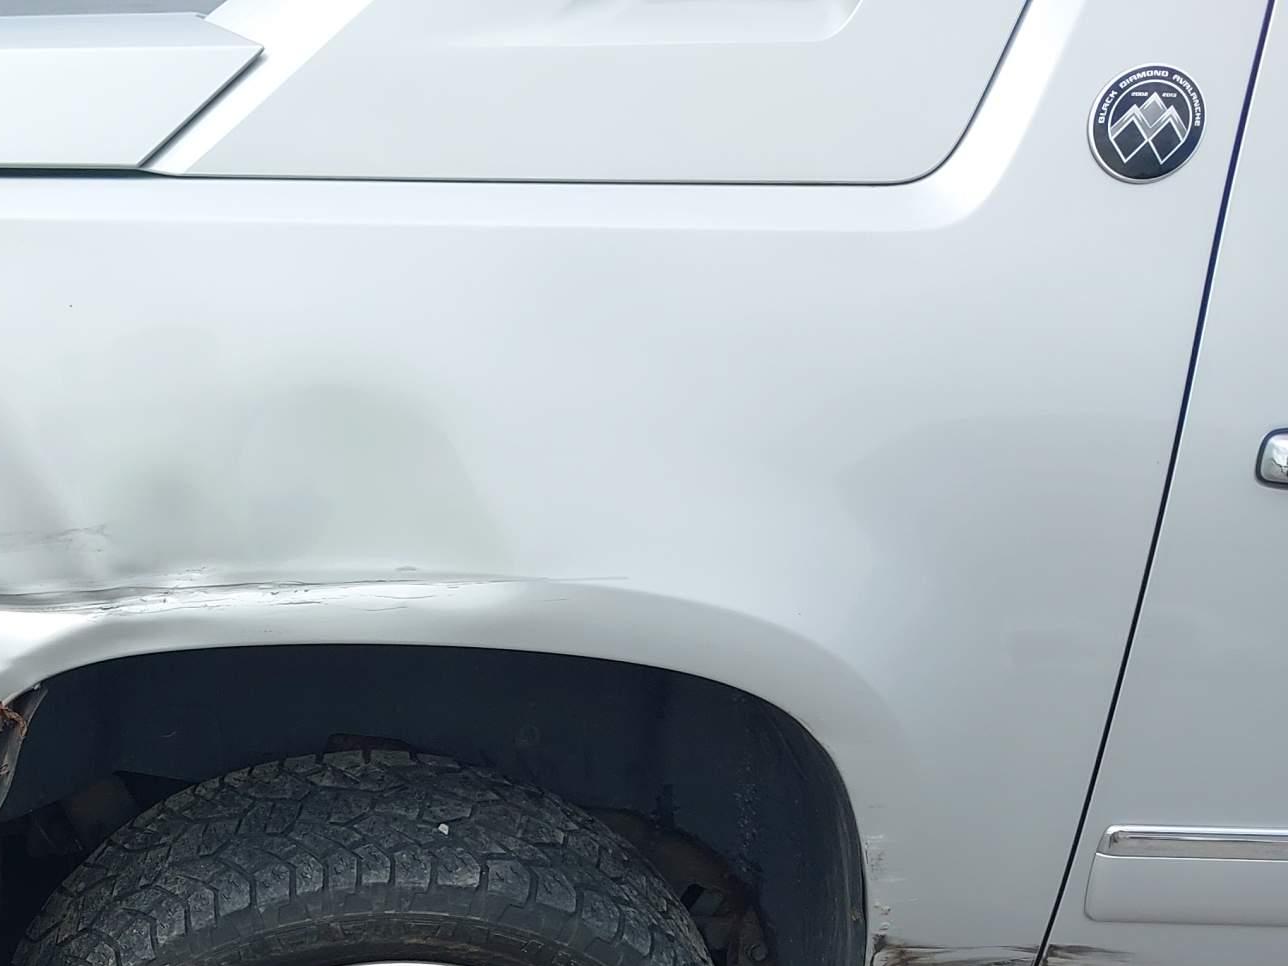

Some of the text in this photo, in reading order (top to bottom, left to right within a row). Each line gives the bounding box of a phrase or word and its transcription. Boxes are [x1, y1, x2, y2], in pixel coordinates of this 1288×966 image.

[1098, 69, 1202, 127] BLACK DIAMOND AVALANCHE
